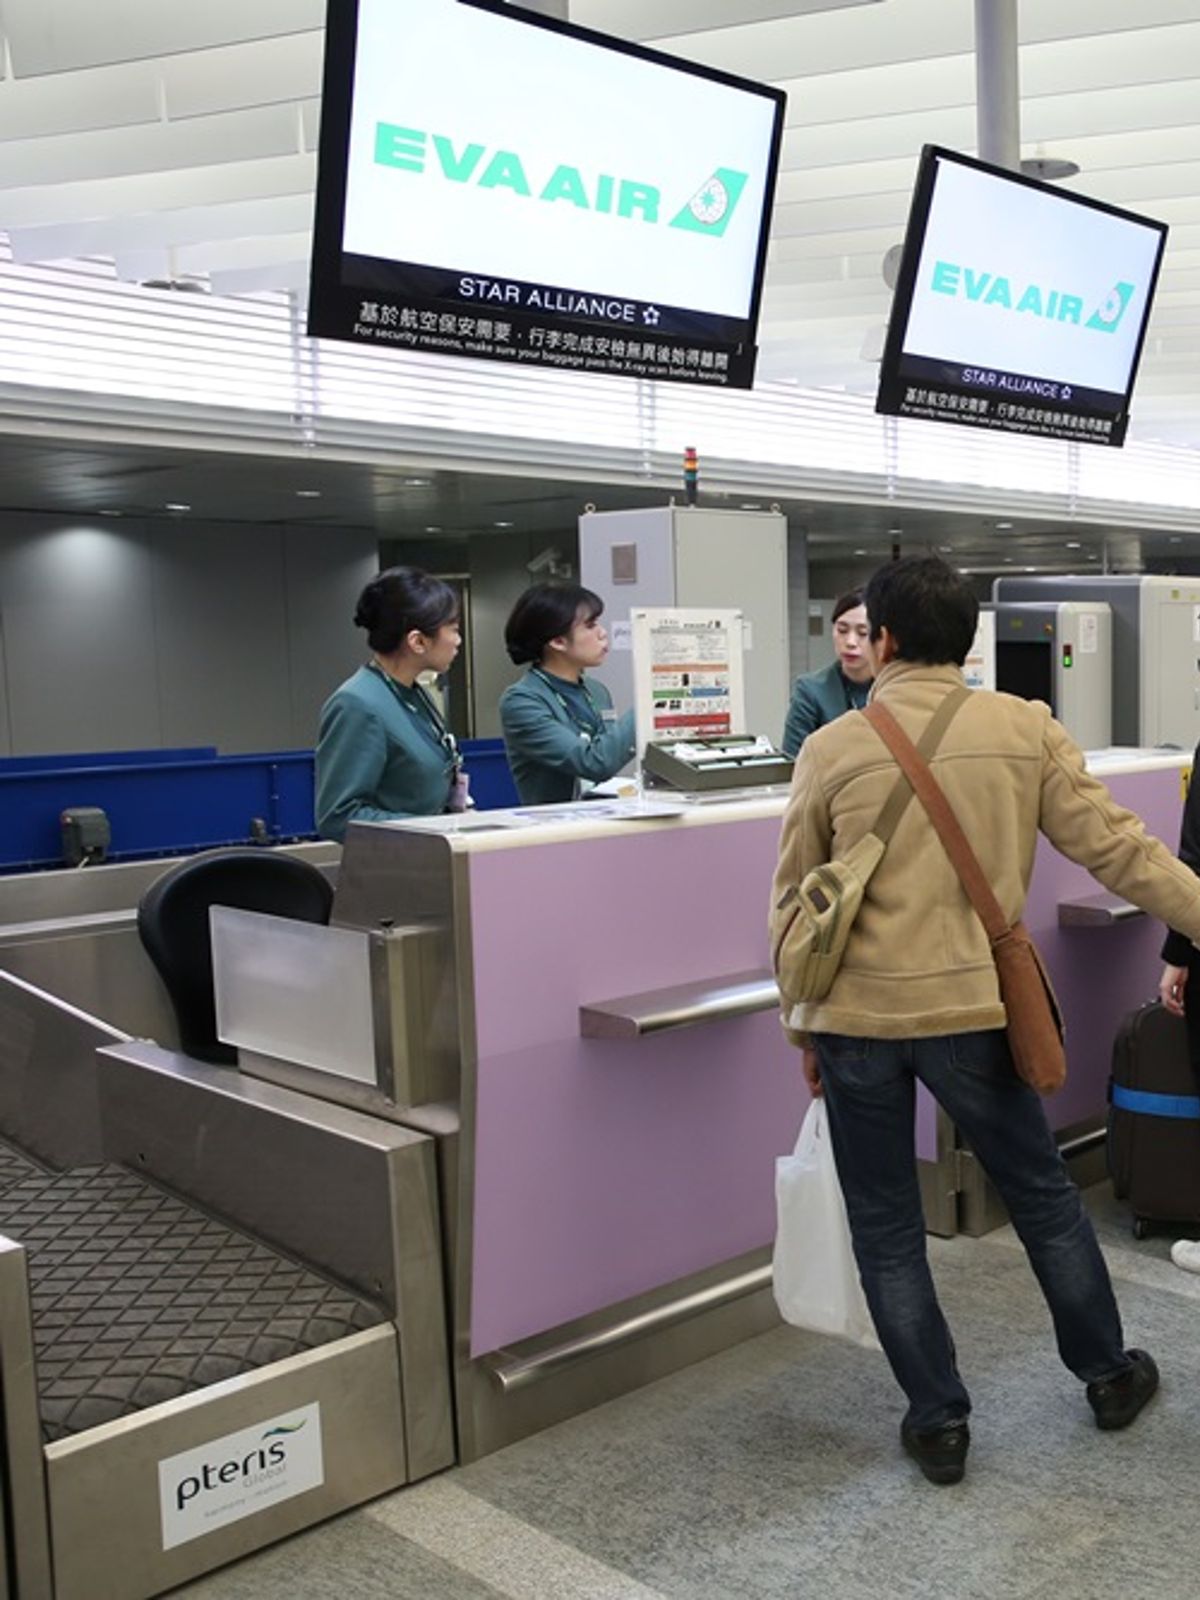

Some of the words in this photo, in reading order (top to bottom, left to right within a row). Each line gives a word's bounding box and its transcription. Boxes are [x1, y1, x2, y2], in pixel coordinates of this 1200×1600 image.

[374, 121, 531, 196] EVA
[539, 164, 661, 224] AIR
[459, 277, 520, 303] STAR
[527, 283, 636, 323] ALLIANCE
[931, 260, 1012, 309] EVA
[1016, 285, 1083, 325] AIR
[353, 323, 373, 337] For
[375, 327, 418, 344] security
[961, 368, 997, 387] STAR
[998, 375, 1059, 399] ALLIANCE
[177, 1440, 286, 1511] pteris
